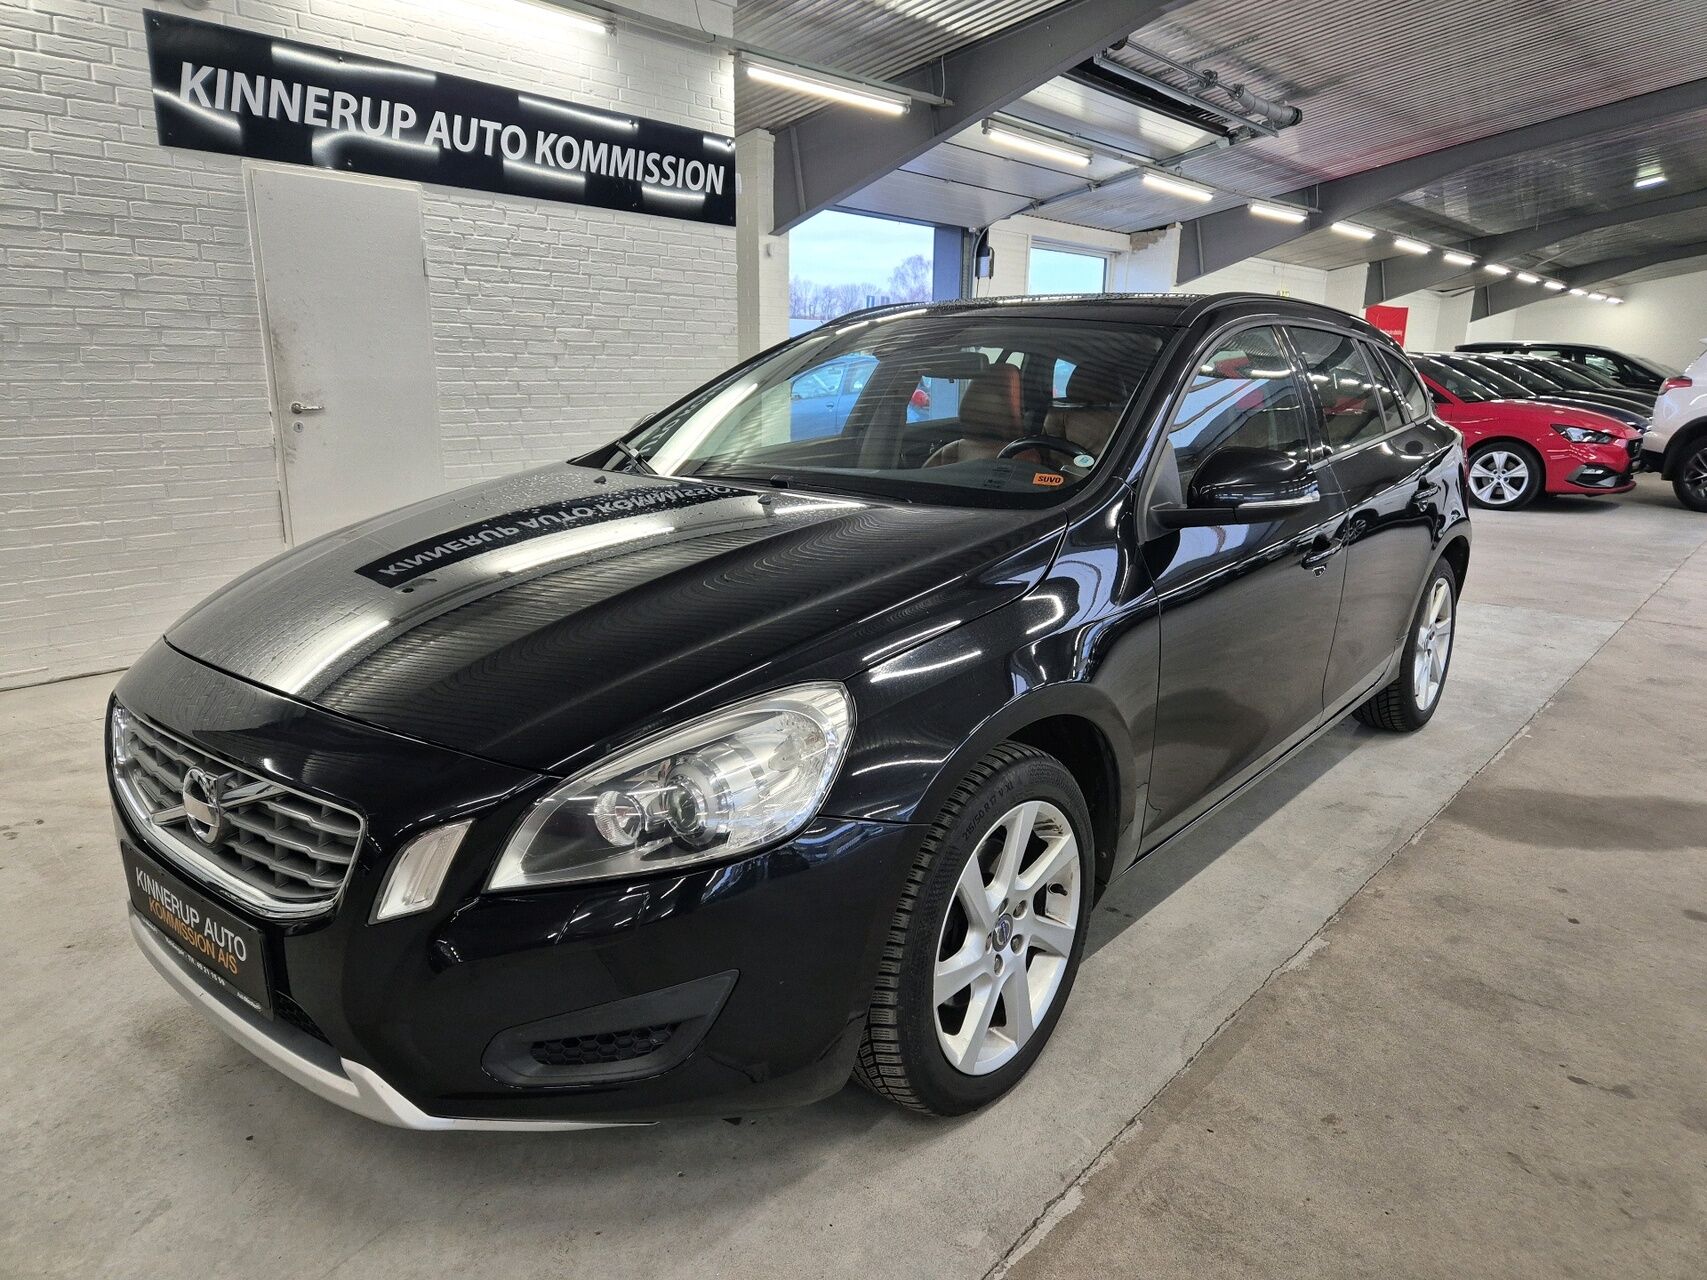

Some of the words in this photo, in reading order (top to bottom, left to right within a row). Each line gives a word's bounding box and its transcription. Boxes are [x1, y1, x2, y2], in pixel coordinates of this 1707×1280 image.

[179, 61, 417, 140] KINNERUP
[424, 111, 527, 160] AUTO
[535, 130, 725, 195] KOMMISSION
[1037, 475, 1062, 484] SUVO
[136, 866, 200, 929] KINNERUP
[204, 917, 247, 962] AUTO
[148, 896, 216, 960] KOMMISSION
[218, 948, 238, 975] A/S
